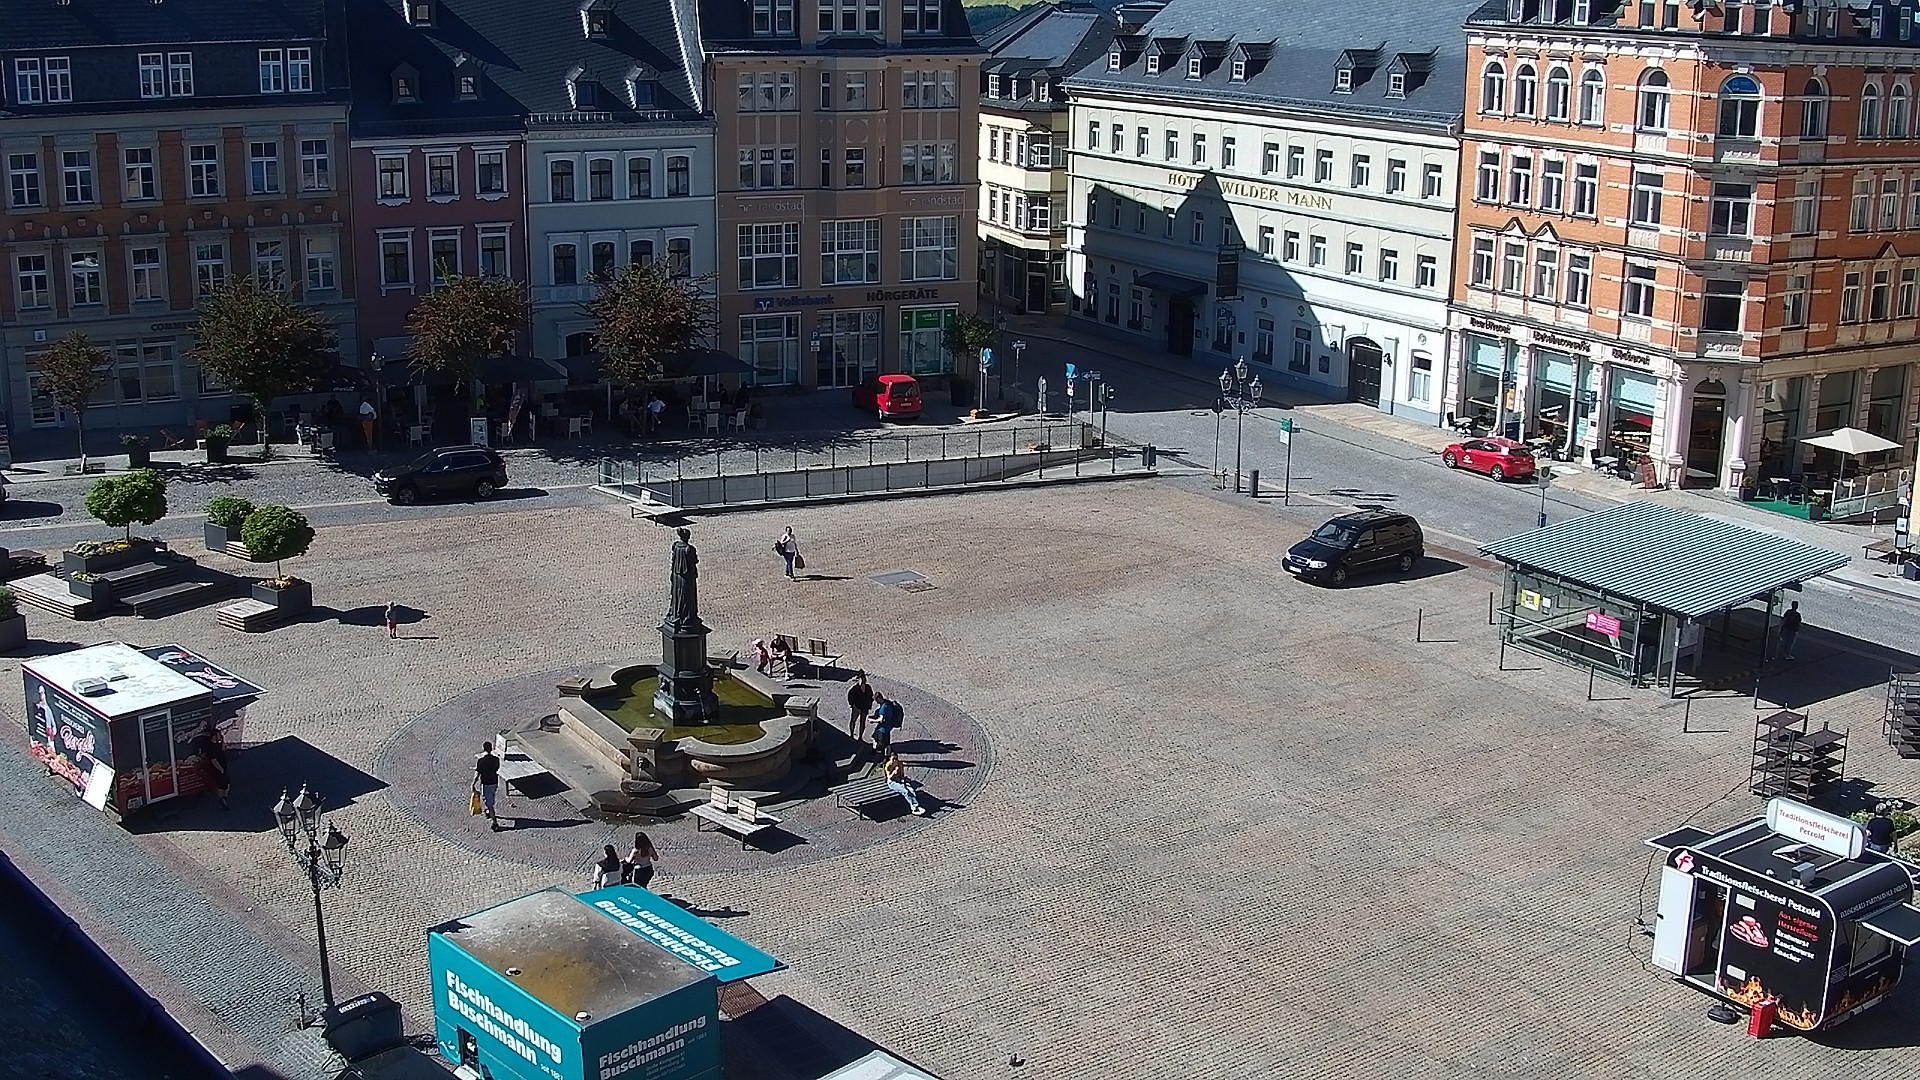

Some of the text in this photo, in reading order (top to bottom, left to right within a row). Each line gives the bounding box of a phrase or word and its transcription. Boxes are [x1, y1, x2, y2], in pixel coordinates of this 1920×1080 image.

[758, 200, 803, 211] randstad
[921, 194, 963, 206] randstad
[1221, 181, 1280, 203] WILDER
[1287, 191, 1333, 211] MANN
[776, 294, 834, 307] Volksbank
[866, 288, 939, 302] HÖRGERÄTE
[1779, 809, 1849, 840] Traditionsfleischerei
[1799, 826, 1825, 841] Petzold
[1701, 865, 1821, 918] Traditionsfleischerei Petzold
[594, 900, 724, 972] Fischhandlung
[637, 910, 742, 967] Buschmann
[445, 968, 563, 1065] Fischhandlung
[447, 989, 538, 1066] Buschmann
[599, 1015, 707, 1069] Fischhandlung
[599, 1037, 685, 1080] Buschmann
